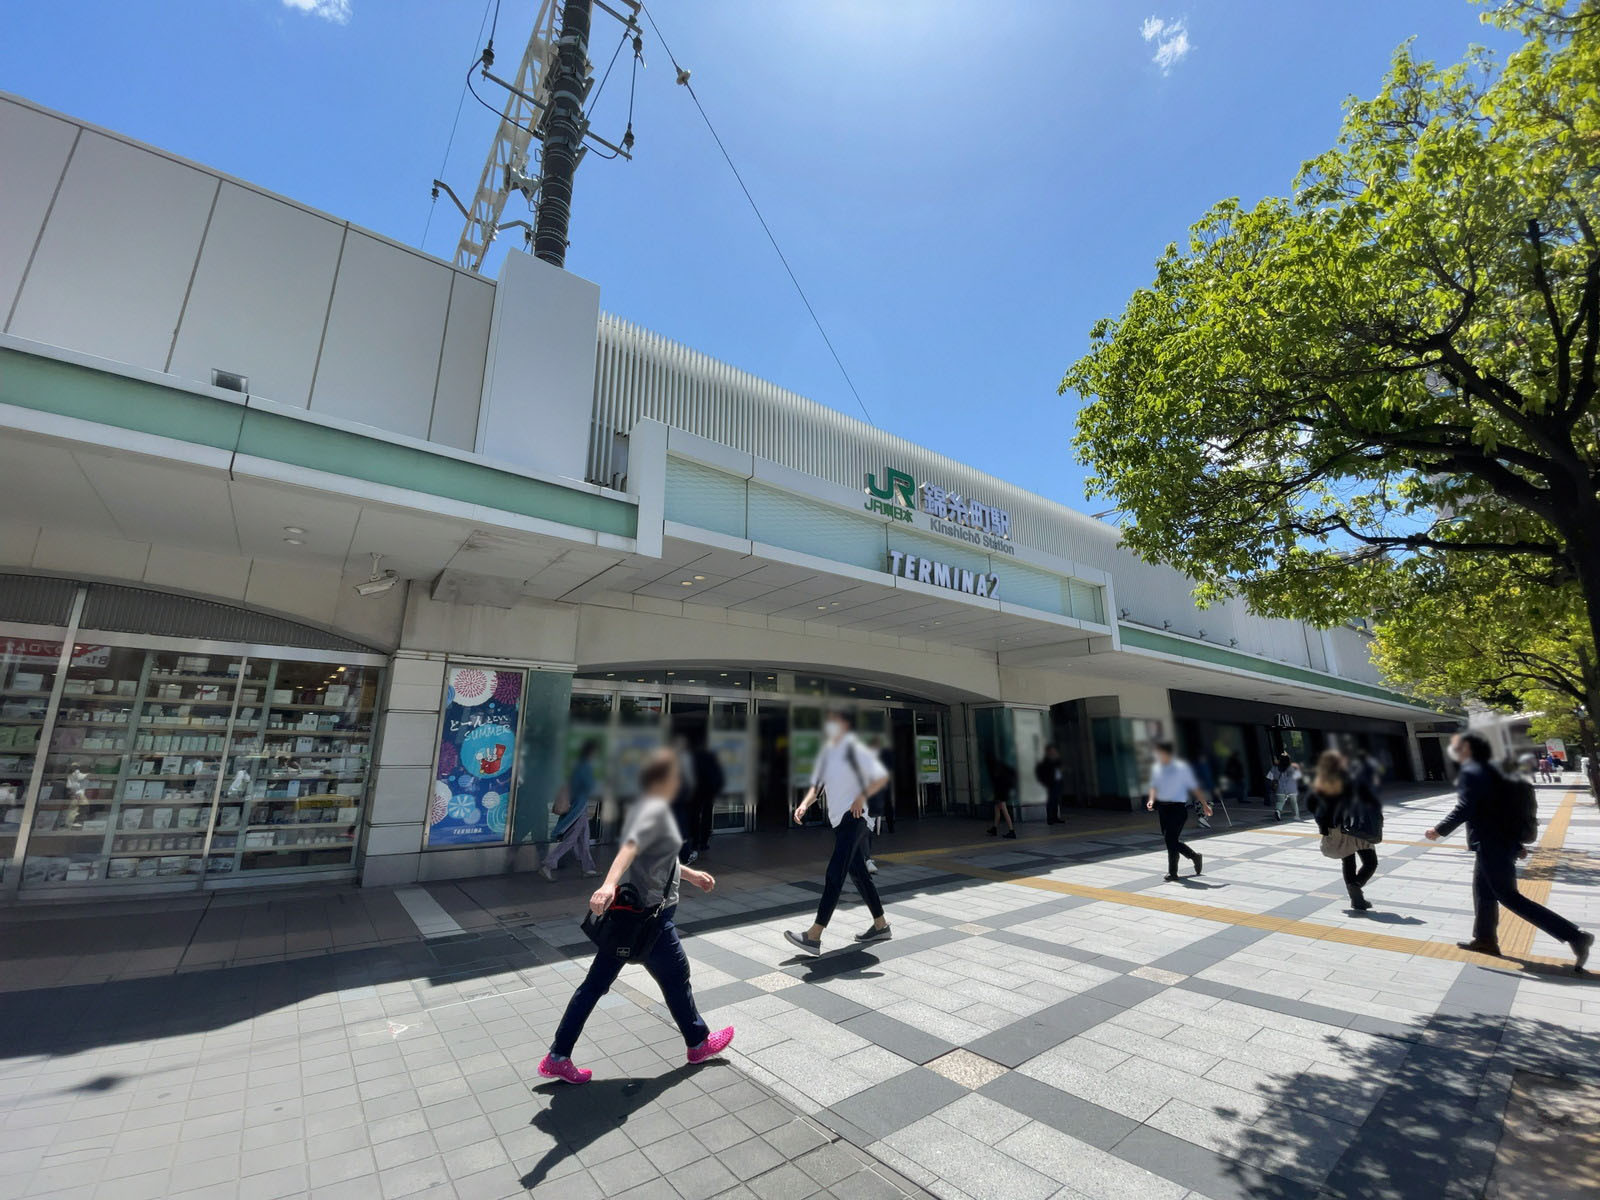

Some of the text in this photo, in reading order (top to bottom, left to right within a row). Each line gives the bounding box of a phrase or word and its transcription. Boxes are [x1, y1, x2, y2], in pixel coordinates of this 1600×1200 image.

[865, 466, 916, 510] JR
[864, 498, 913, 523] JR東日本
[920, 481, 1010, 540] 錦糸町駅
[982, 534, 1015, 556] Station
[889, 550, 1001, 599] TERMINA2
[464, 724, 511, 741] SUMMER
[1276, 713, 1296, 728] ZARA
